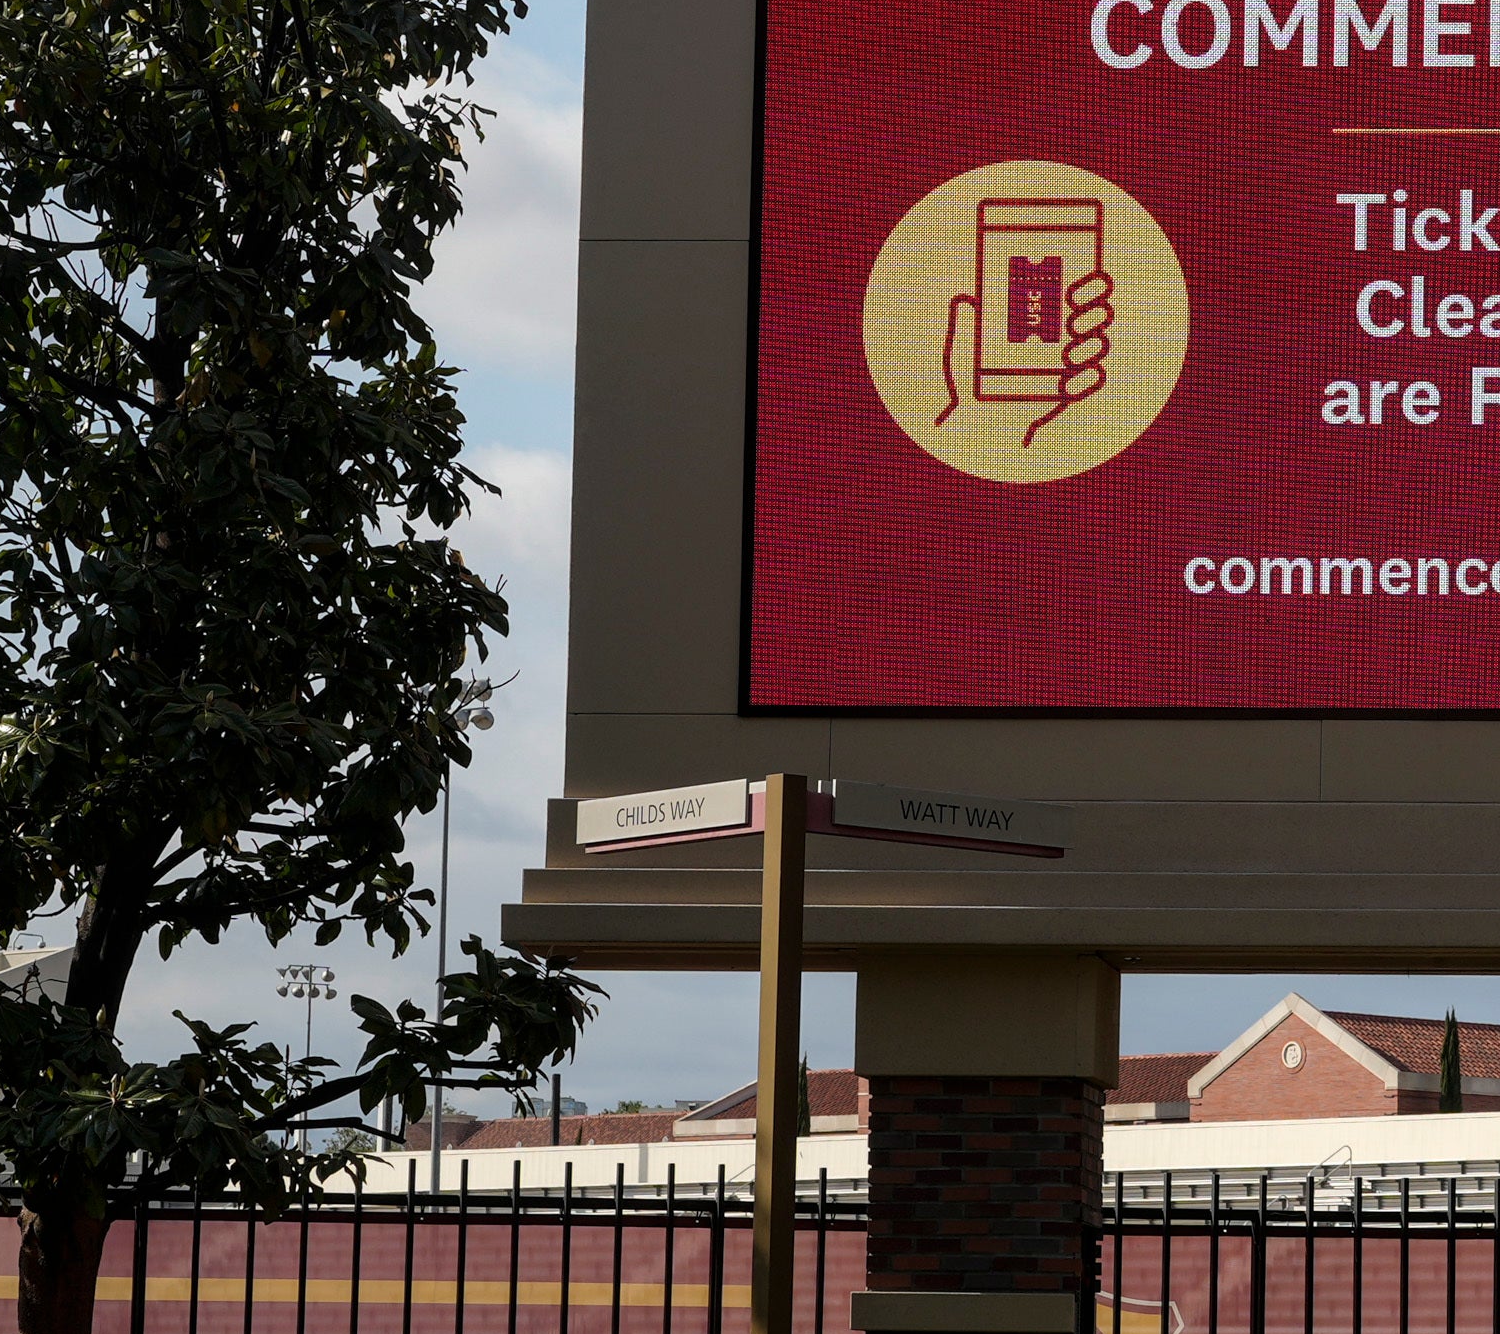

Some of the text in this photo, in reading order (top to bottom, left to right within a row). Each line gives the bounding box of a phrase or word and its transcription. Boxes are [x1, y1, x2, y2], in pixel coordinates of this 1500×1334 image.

[1026, 289, 1042, 325] USC
[1321, 380, 1441, 425] are
[616, 797, 705, 827] CHILDS WAY
[900, 799, 1014, 830] WATT WAY
